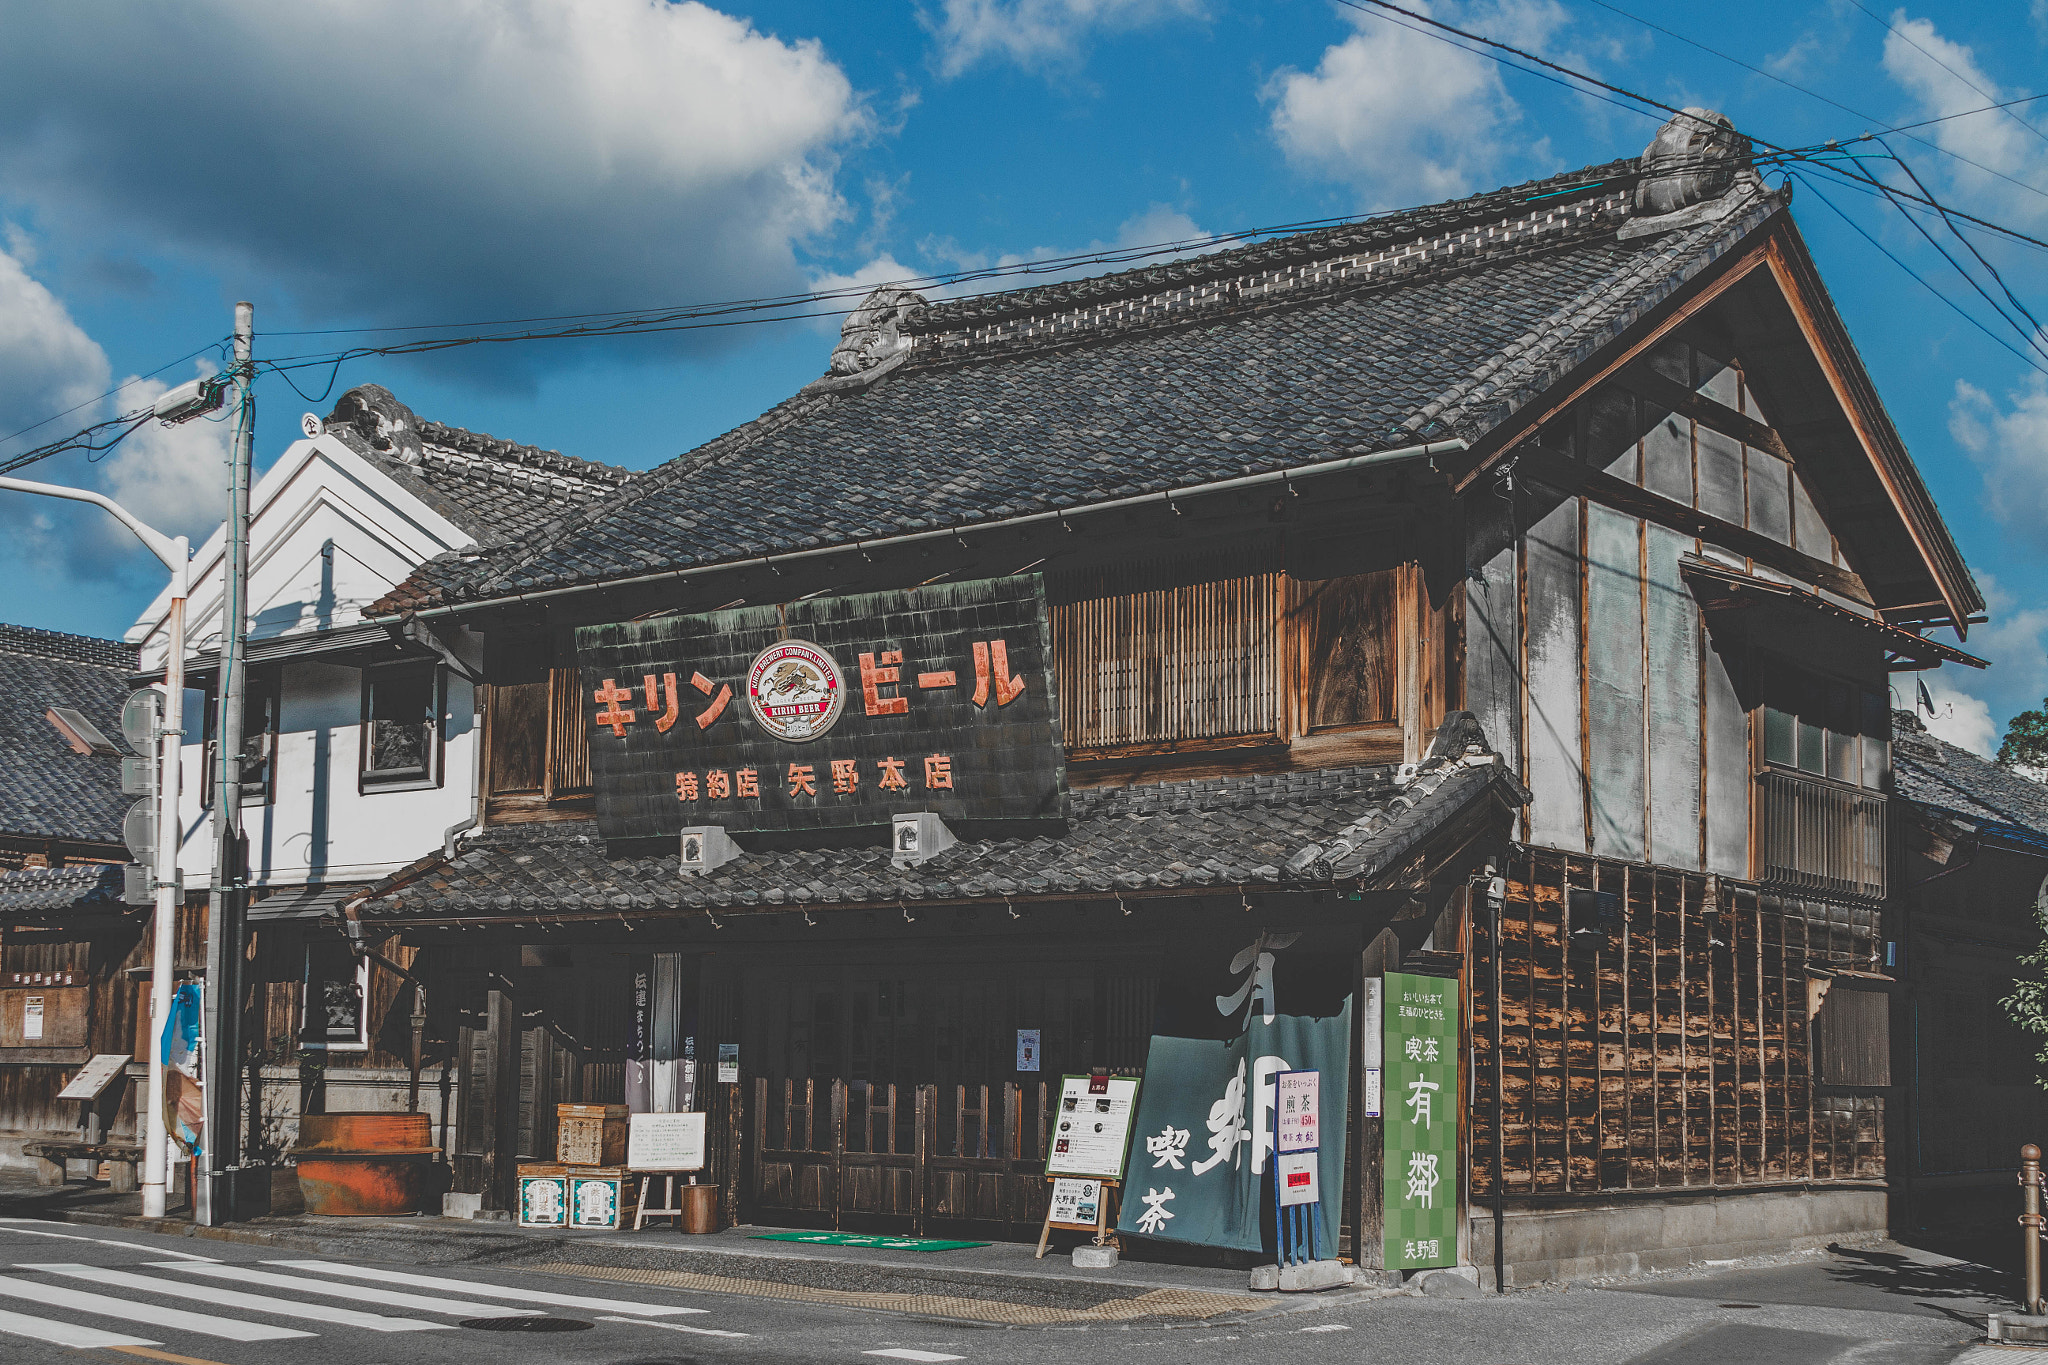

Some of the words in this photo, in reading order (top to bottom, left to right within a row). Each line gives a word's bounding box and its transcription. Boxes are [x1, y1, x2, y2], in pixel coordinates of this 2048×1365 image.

[751, 669, 762, 689] KIRIN
[759, 649, 784, 670] BREWERY
[594, 670, 732, 738] キリン
[857, 638, 1026, 717] ビール
[771, 705, 797, 716] KIRIN
[798, 703, 821, 714] BEER
[675, 767, 760, 801] 特約店
[787, 753, 954, 798] 矢野本店
[1403, 991, 1443, 1005] おいしいお茶で
[1405, 1035, 1439, 1063] 喫茶
[1285, 1093, 1311, 1114] 煎茶
[1136, 1124, 1191, 1234] 喫茶
